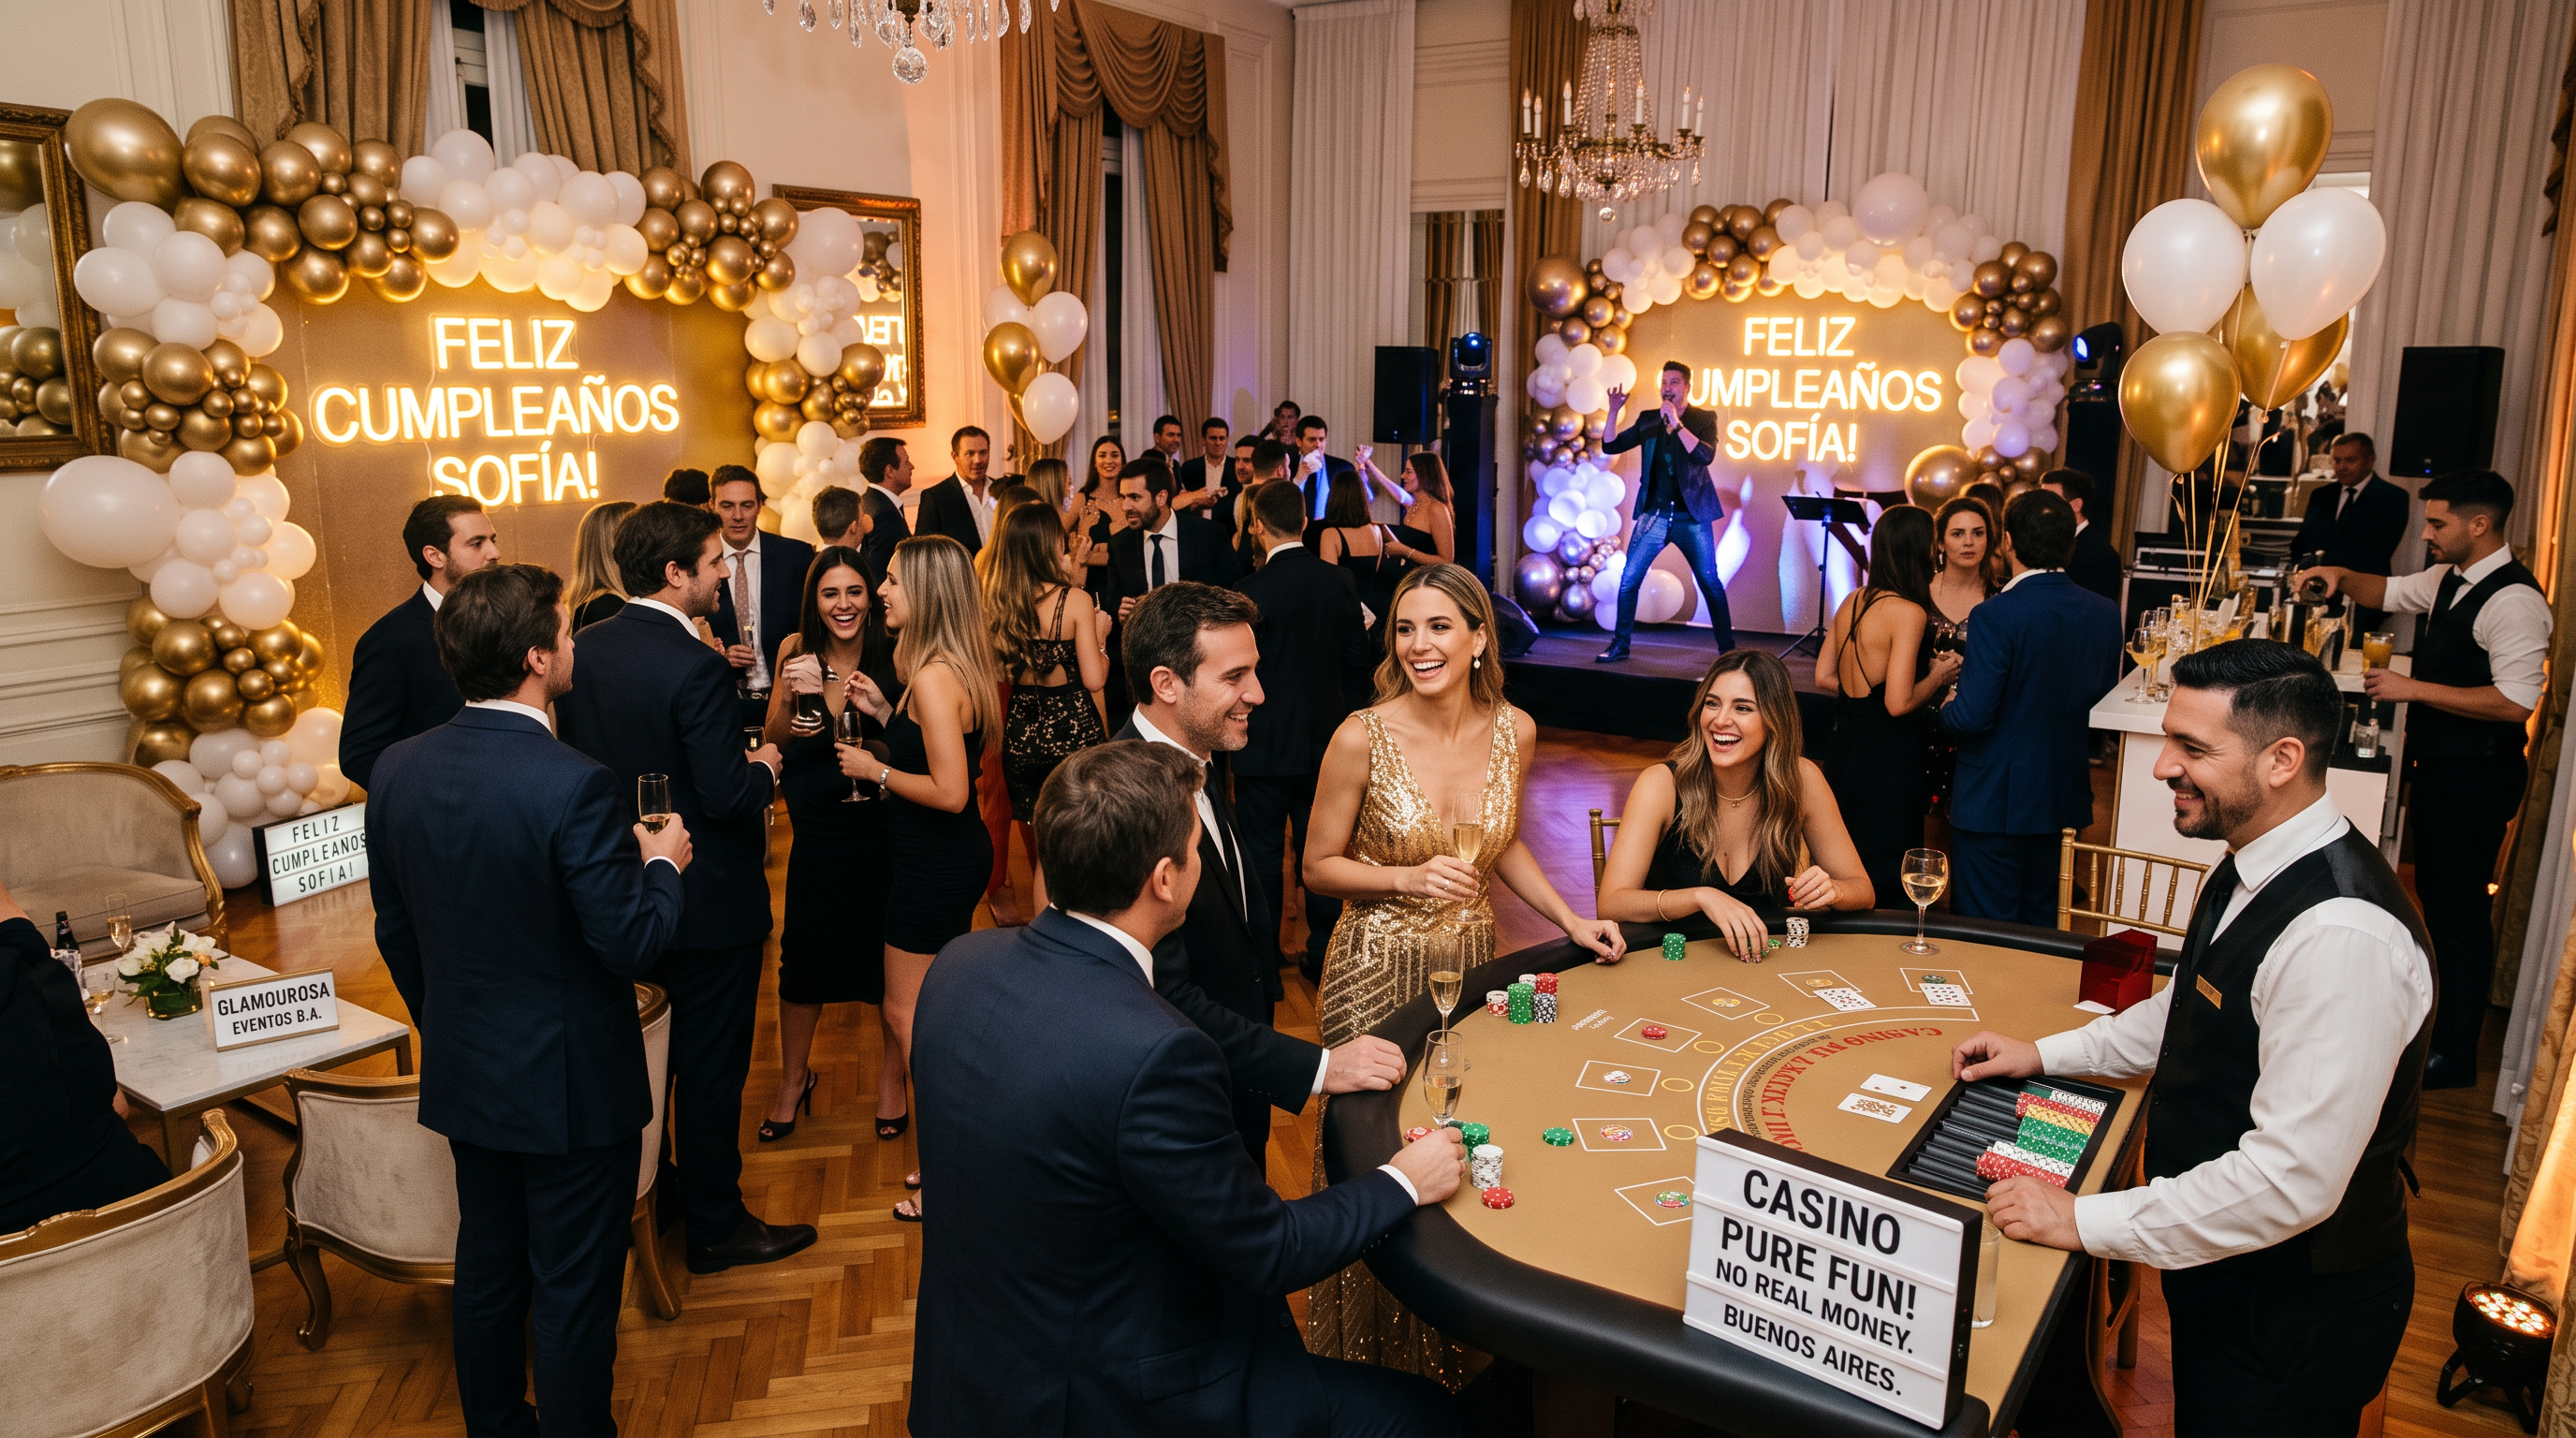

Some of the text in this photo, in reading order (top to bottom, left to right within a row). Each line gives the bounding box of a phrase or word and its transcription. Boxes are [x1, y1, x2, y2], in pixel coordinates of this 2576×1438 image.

[433, 316, 579, 371] FELIZ
[1743, 316, 1856, 358] FELIZ
[315, 374, 681, 444] CUMPLEAÑOS
[1656, 361, 1943, 413] UMPLEAÑOS
[1724, 412, 1858, 463] SOFÍA!
[432, 440, 600, 506] SOFÍA!
[271, 832, 367, 875] CUMPLEANOS
[292, 815, 340, 844] FELIZ
[298, 861, 354, 893] SOFIA!
[217, 981, 330, 1016] GLAMOUROSA
[232, 1006, 322, 1035] EVENTOS B.A.
[1743, 1168, 1901, 1255] CASINO
[1720, 1215, 1917, 1321] PURE FUN!
[1715, 1257, 1913, 1355] NO REAL MONEY.
[1723, 1303, 1902, 1396] BUENOS AIRES.
